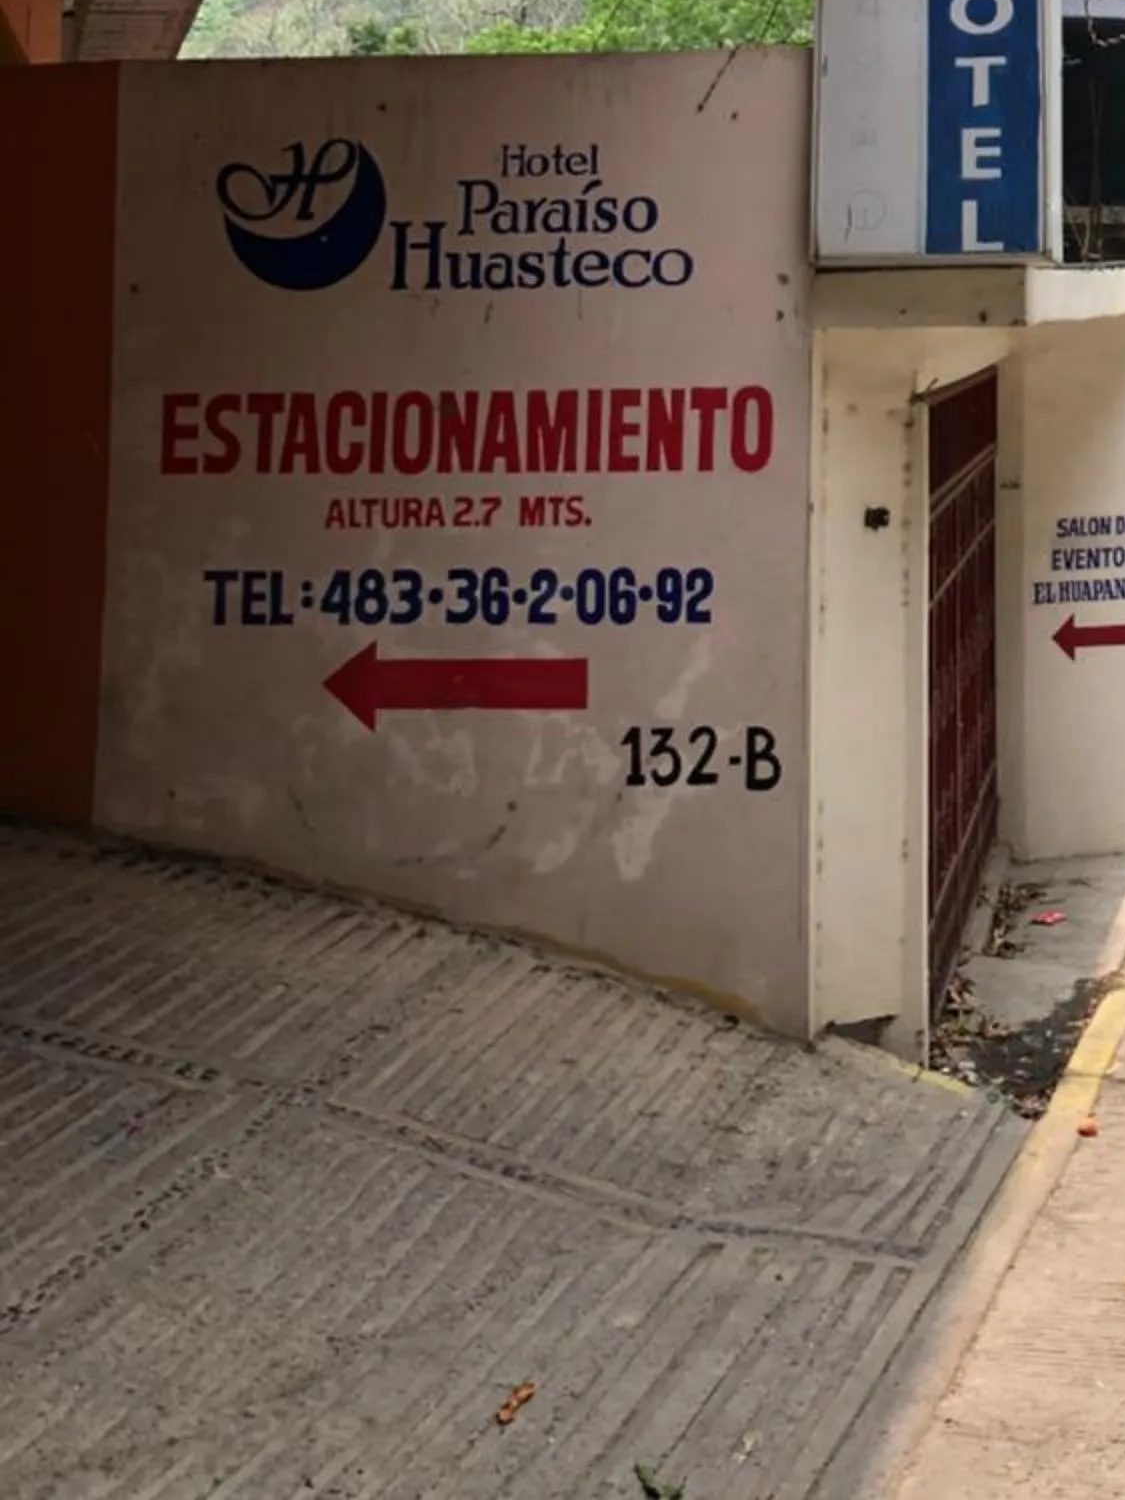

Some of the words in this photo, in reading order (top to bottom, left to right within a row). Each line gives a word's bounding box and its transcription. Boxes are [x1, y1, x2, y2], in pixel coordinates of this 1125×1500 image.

[501, 143, 599, 178] Hotel
[457, 179, 658, 236] Paraíso
[389, 220, 694, 290] Huasteco
[160, 385, 774, 475] ESTACIONAMIENTO
[324, 497, 446, 530] ALTURA
[452, 497, 501, 528] 2.7
[518, 496, 592, 528] MTS.
[1056, 517, 1110, 538] SALON
[1034, 581, 1056, 604] EL
[620, 726, 782, 791] 132-B
